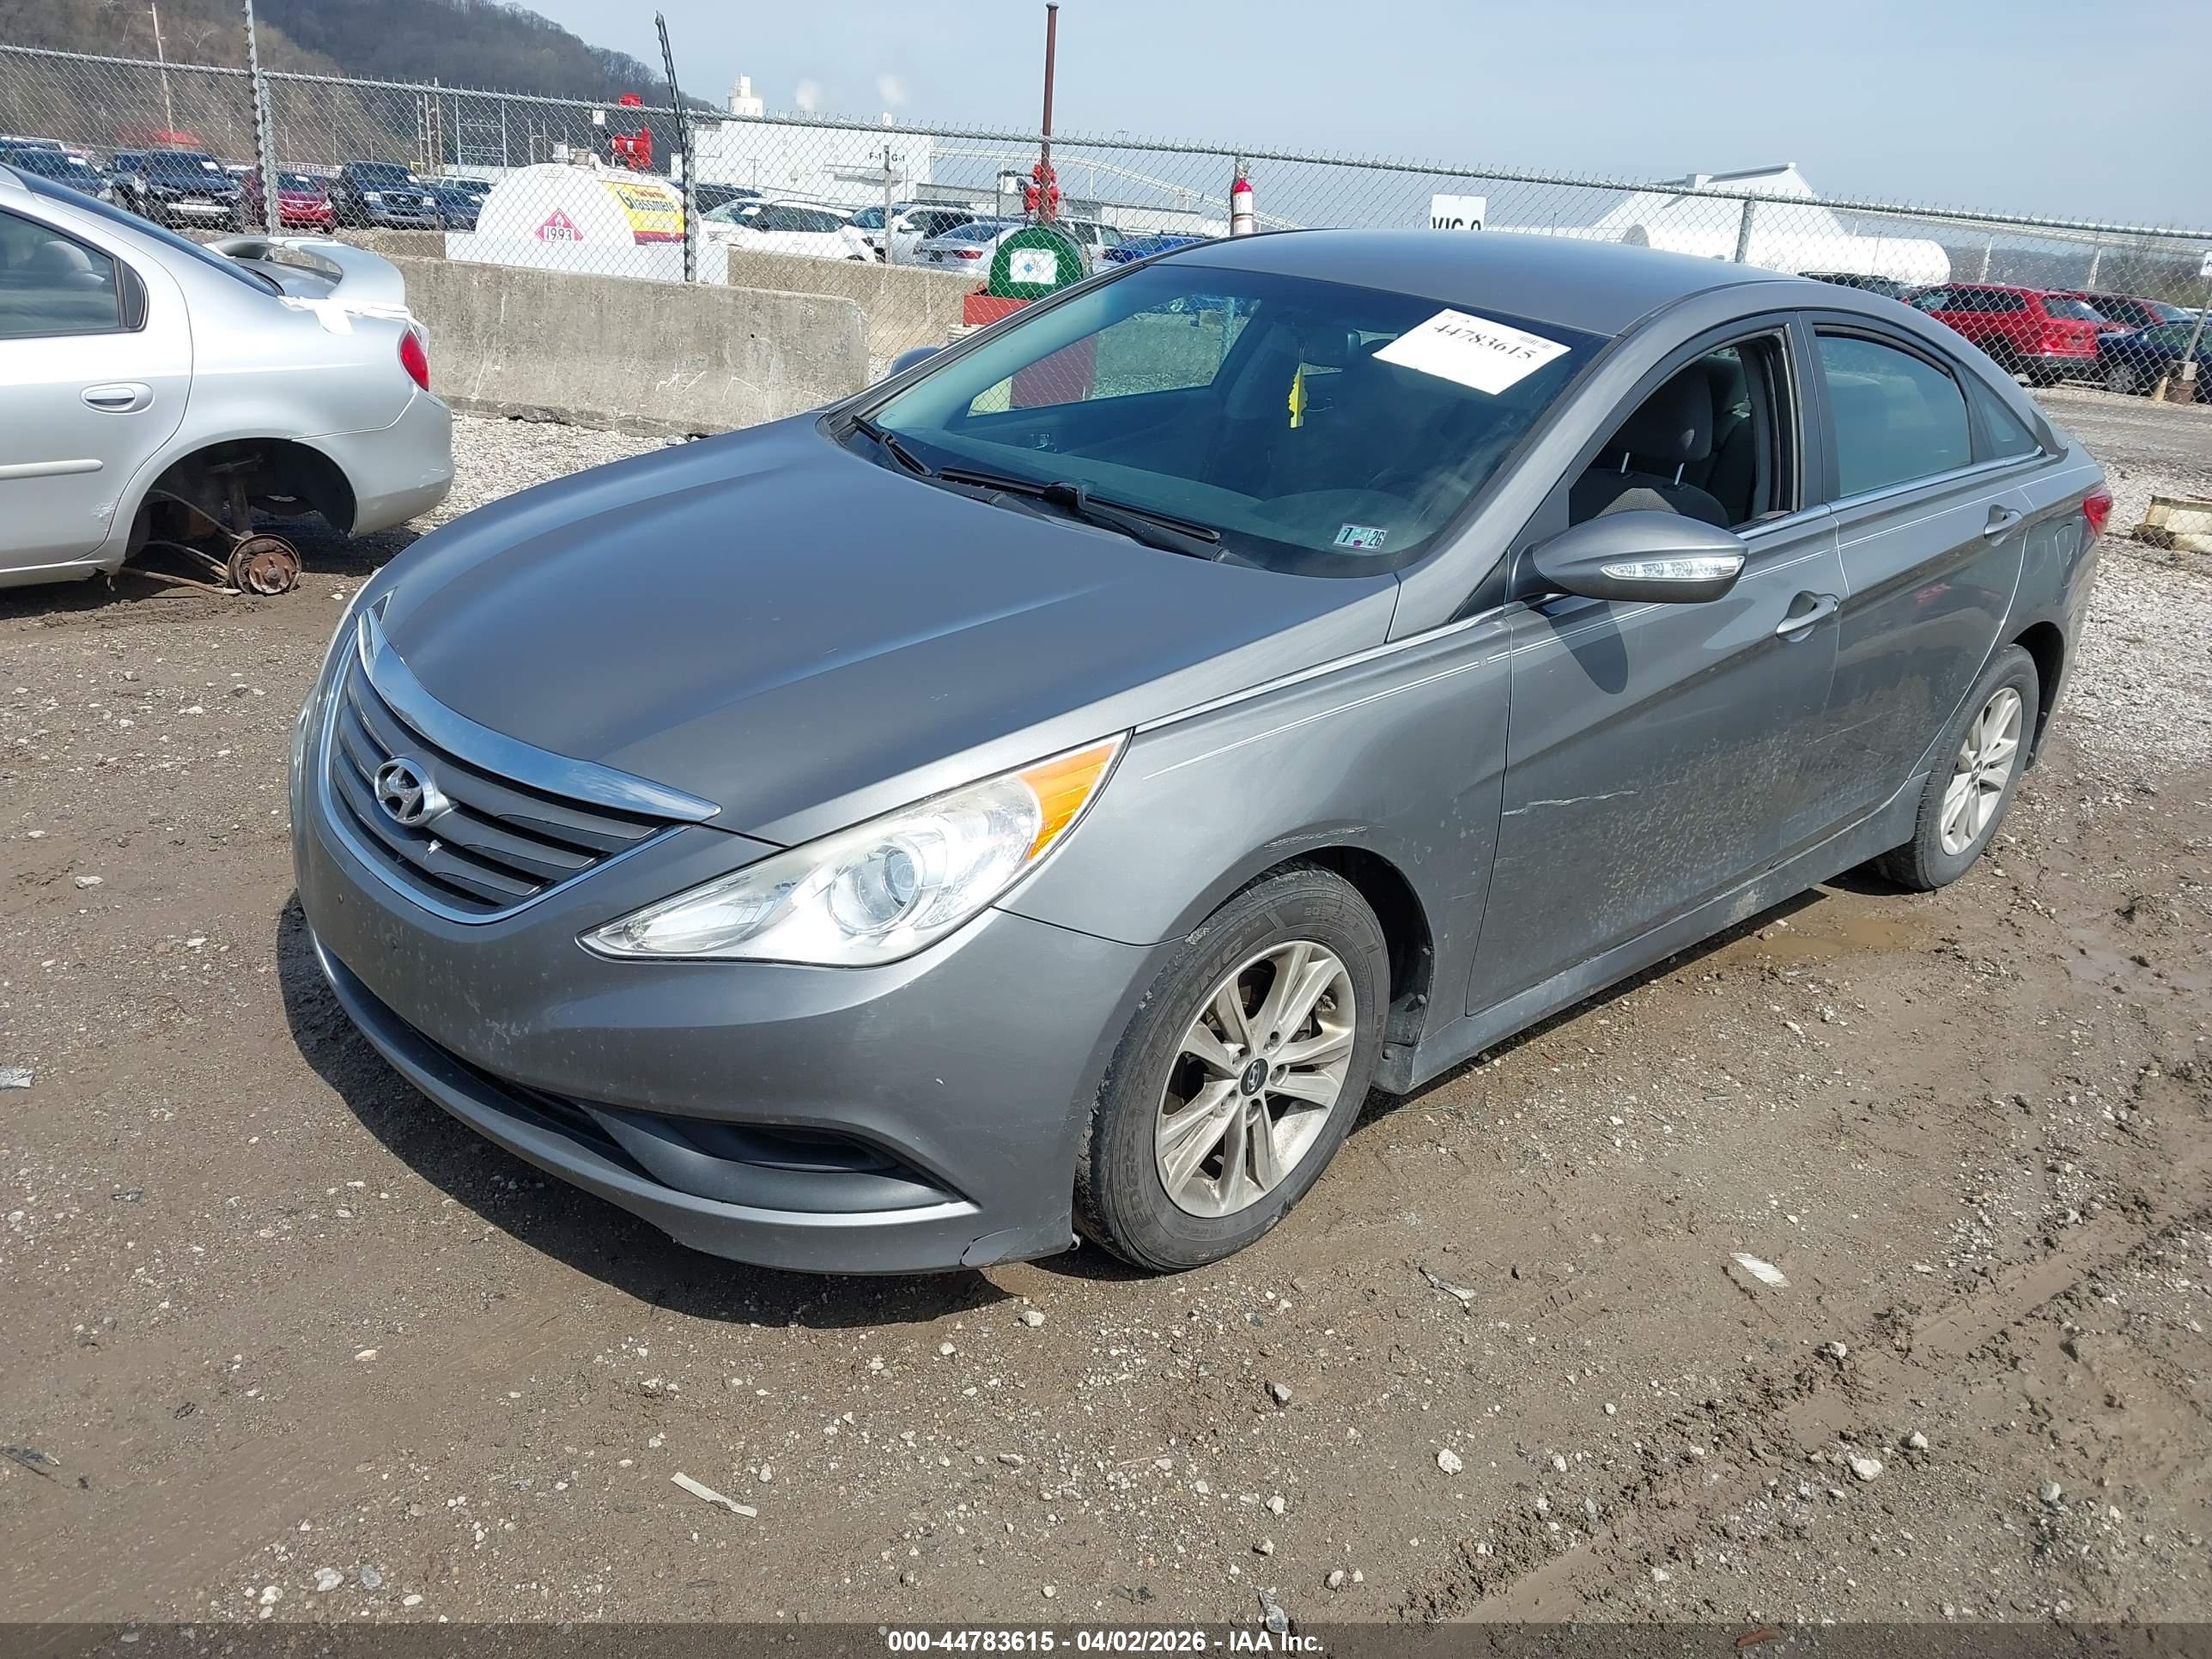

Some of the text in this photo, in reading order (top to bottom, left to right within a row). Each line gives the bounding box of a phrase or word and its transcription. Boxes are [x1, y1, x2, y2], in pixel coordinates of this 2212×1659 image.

[891, 154, 905, 162] G-1
[616, 190, 677, 213] Glassmere
[546, 227, 573, 241] 1993
[1434, 325, 1537, 359] 44783615
[1342, 527, 1384, 547] 7 26
